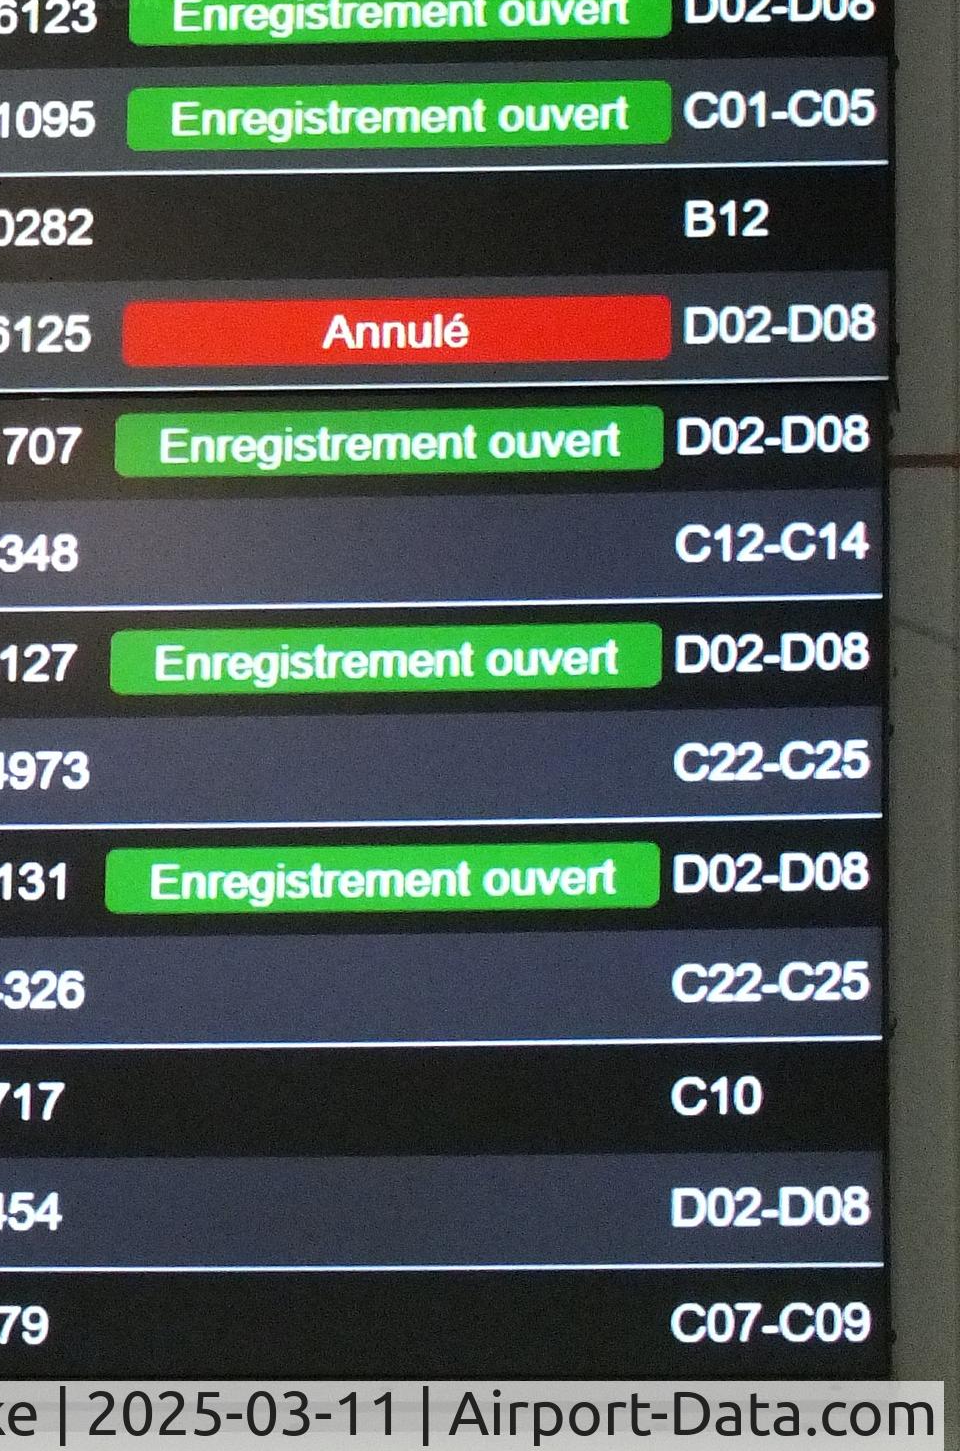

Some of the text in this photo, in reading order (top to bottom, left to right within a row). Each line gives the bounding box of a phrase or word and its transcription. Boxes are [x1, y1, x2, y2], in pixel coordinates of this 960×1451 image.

[171, 96, 629, 143] Enregistrement ouvert
[684, 88, 873, 129] C01-C05
[686, 199, 769, 238] B12
[322, 313, 469, 349] Annulé
[685, 303, 873, 345] D02-D08
[160, 422, 621, 470] Enregistrement ouvert
[675, 521, 870, 563] C12-C14
[673, 739, 871, 782] C22-C25
[150, 859, 616, 908] Enregistrement ouvert
[671, 960, 871, 1004] C22-C25
[671, 1185, 872, 1228] D02-D08
